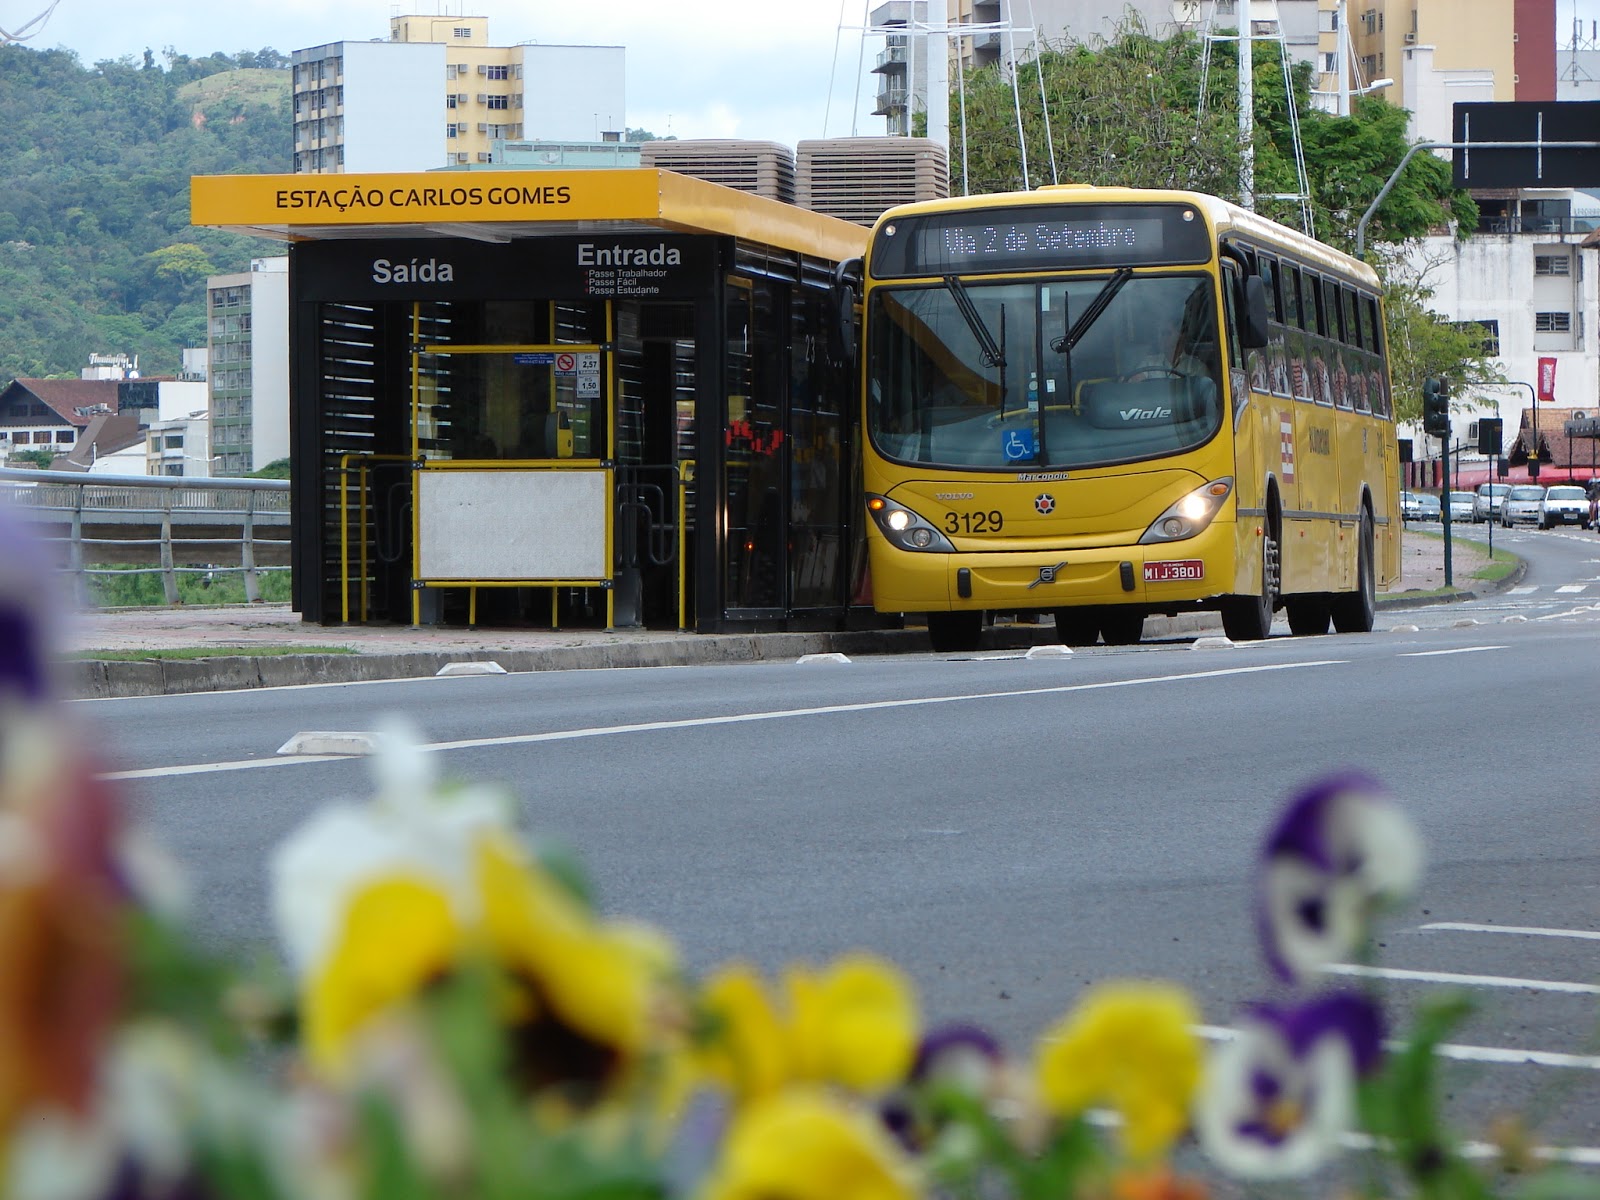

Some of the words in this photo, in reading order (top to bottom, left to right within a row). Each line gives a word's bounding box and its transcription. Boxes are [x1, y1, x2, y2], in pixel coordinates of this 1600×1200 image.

[276, 185, 384, 212] ESTAÇÃO
[389, 187, 483, 207] CARLOS
[488, 186, 571, 205] GOMES
[944, 227, 977, 254] Via
[983, 226, 998, 253] 2
[1005, 225, 1029, 251] de
[1035, 221, 1136, 250] Setembro
[578, 243, 681, 266] Entrada
[372, 258, 454, 284] Saída
[588, 269, 615, 278] Passe
[617, 269, 668, 278] Trabalhador
[588, 278, 615, 287] Passe
[617, 277, 637, 286] Fácil
[588, 286, 615, 295] Passe
[617, 286, 660, 294] Estudante
[582, 361, 597, 369] 2,57
[582, 382, 597, 390] 1,50
[1119, 406, 1172, 421] Viale
[1017, 472, 1070, 481] Marcopolo
[936, 492, 975, 500] VOLVO
[944, 510, 1004, 534] 3129
